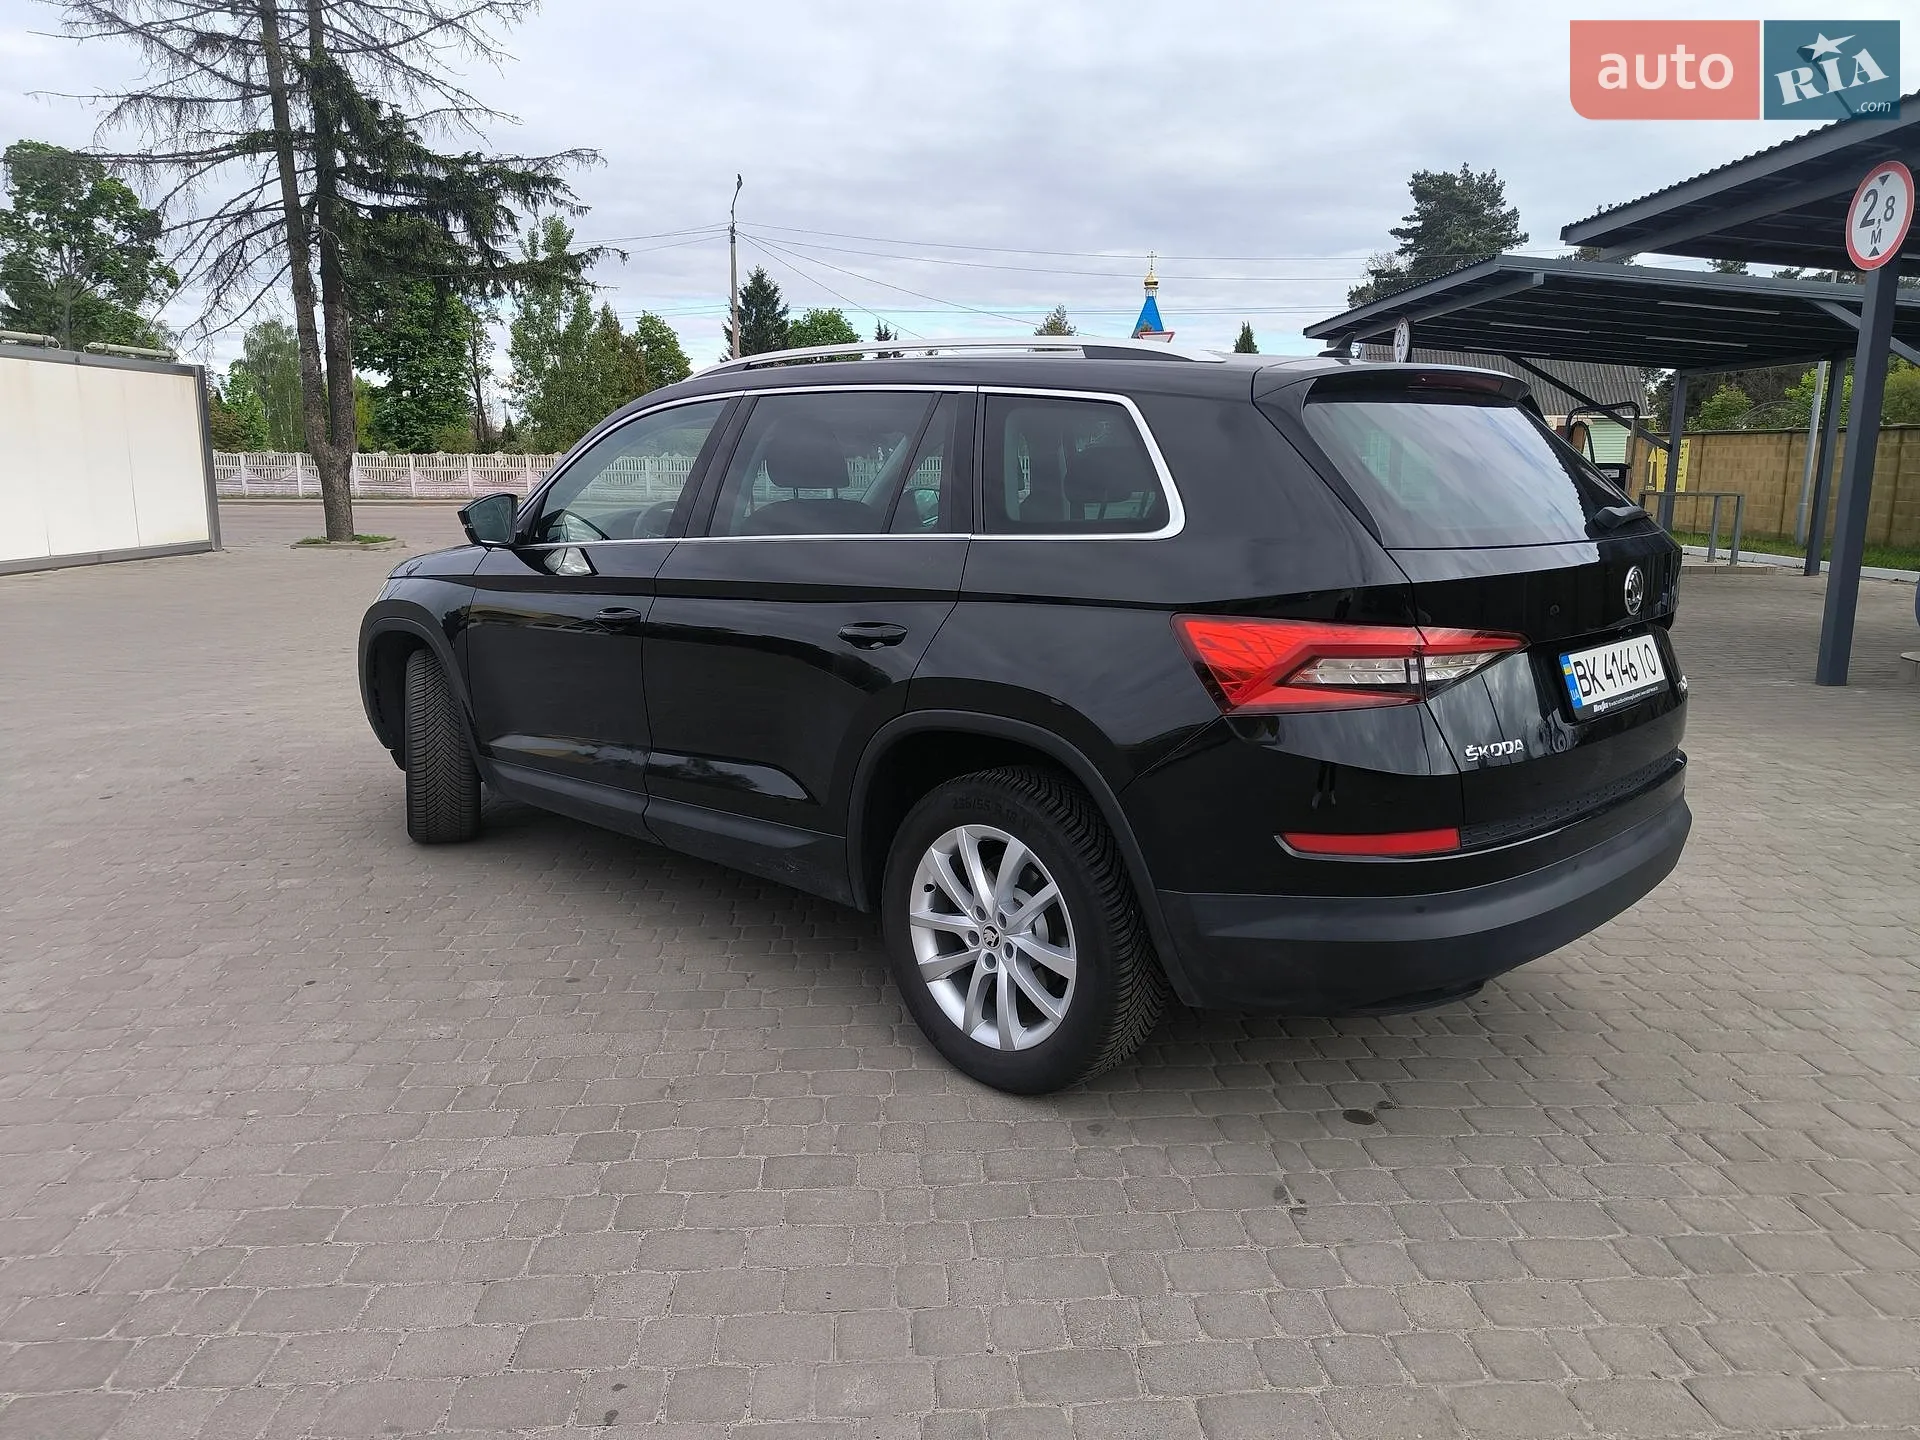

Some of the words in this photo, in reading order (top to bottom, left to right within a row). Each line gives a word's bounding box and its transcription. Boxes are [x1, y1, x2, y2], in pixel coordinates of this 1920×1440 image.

[1859, 189, 1896, 230] 2,8
[1573, 656, 1606, 698] BK
[1604, 647, 1638, 689] 4146
[1570, 689, 1580, 701] UA
[1465, 739, 1524, 762] ŠKODA
